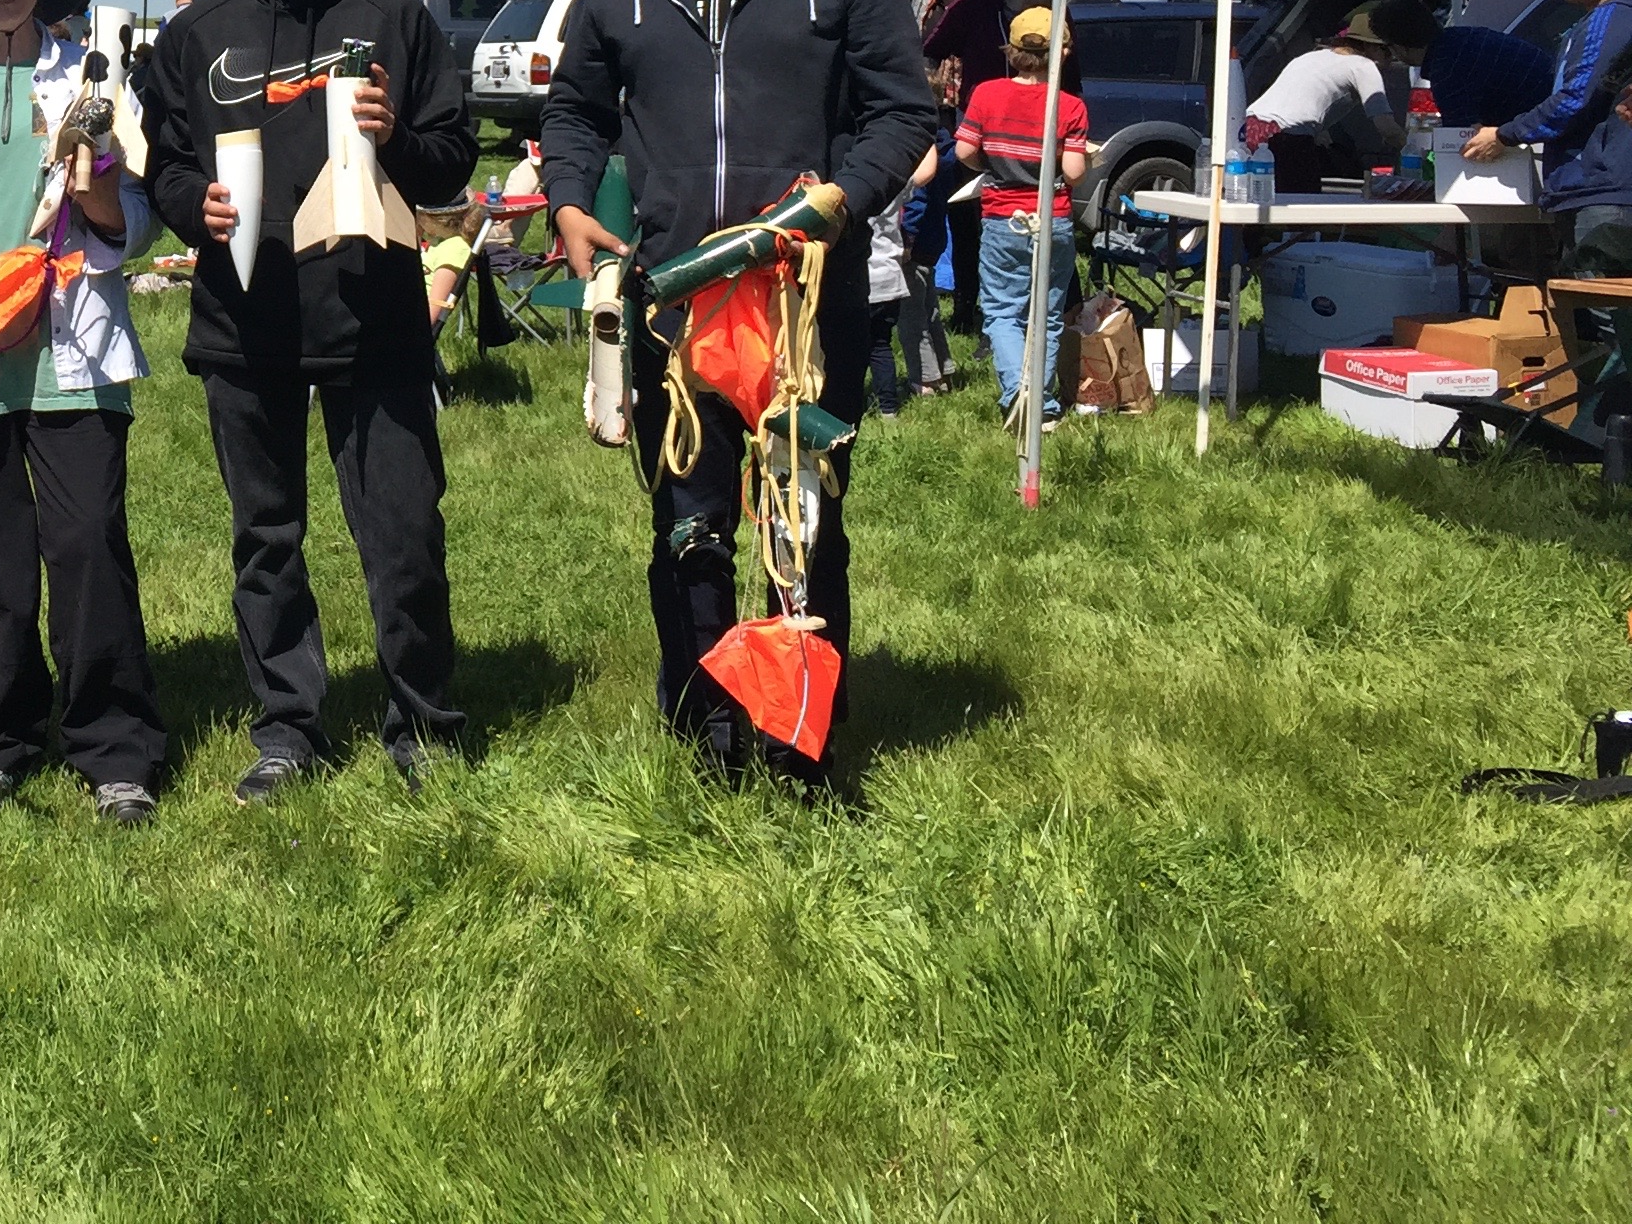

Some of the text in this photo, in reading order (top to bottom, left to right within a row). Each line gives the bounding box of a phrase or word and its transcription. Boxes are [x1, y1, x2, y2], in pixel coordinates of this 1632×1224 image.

[1345, 359, 1375, 377] Office
[1376, 367, 1407, 386] Paper
[1436, 375, 1491, 385] Office Paper
